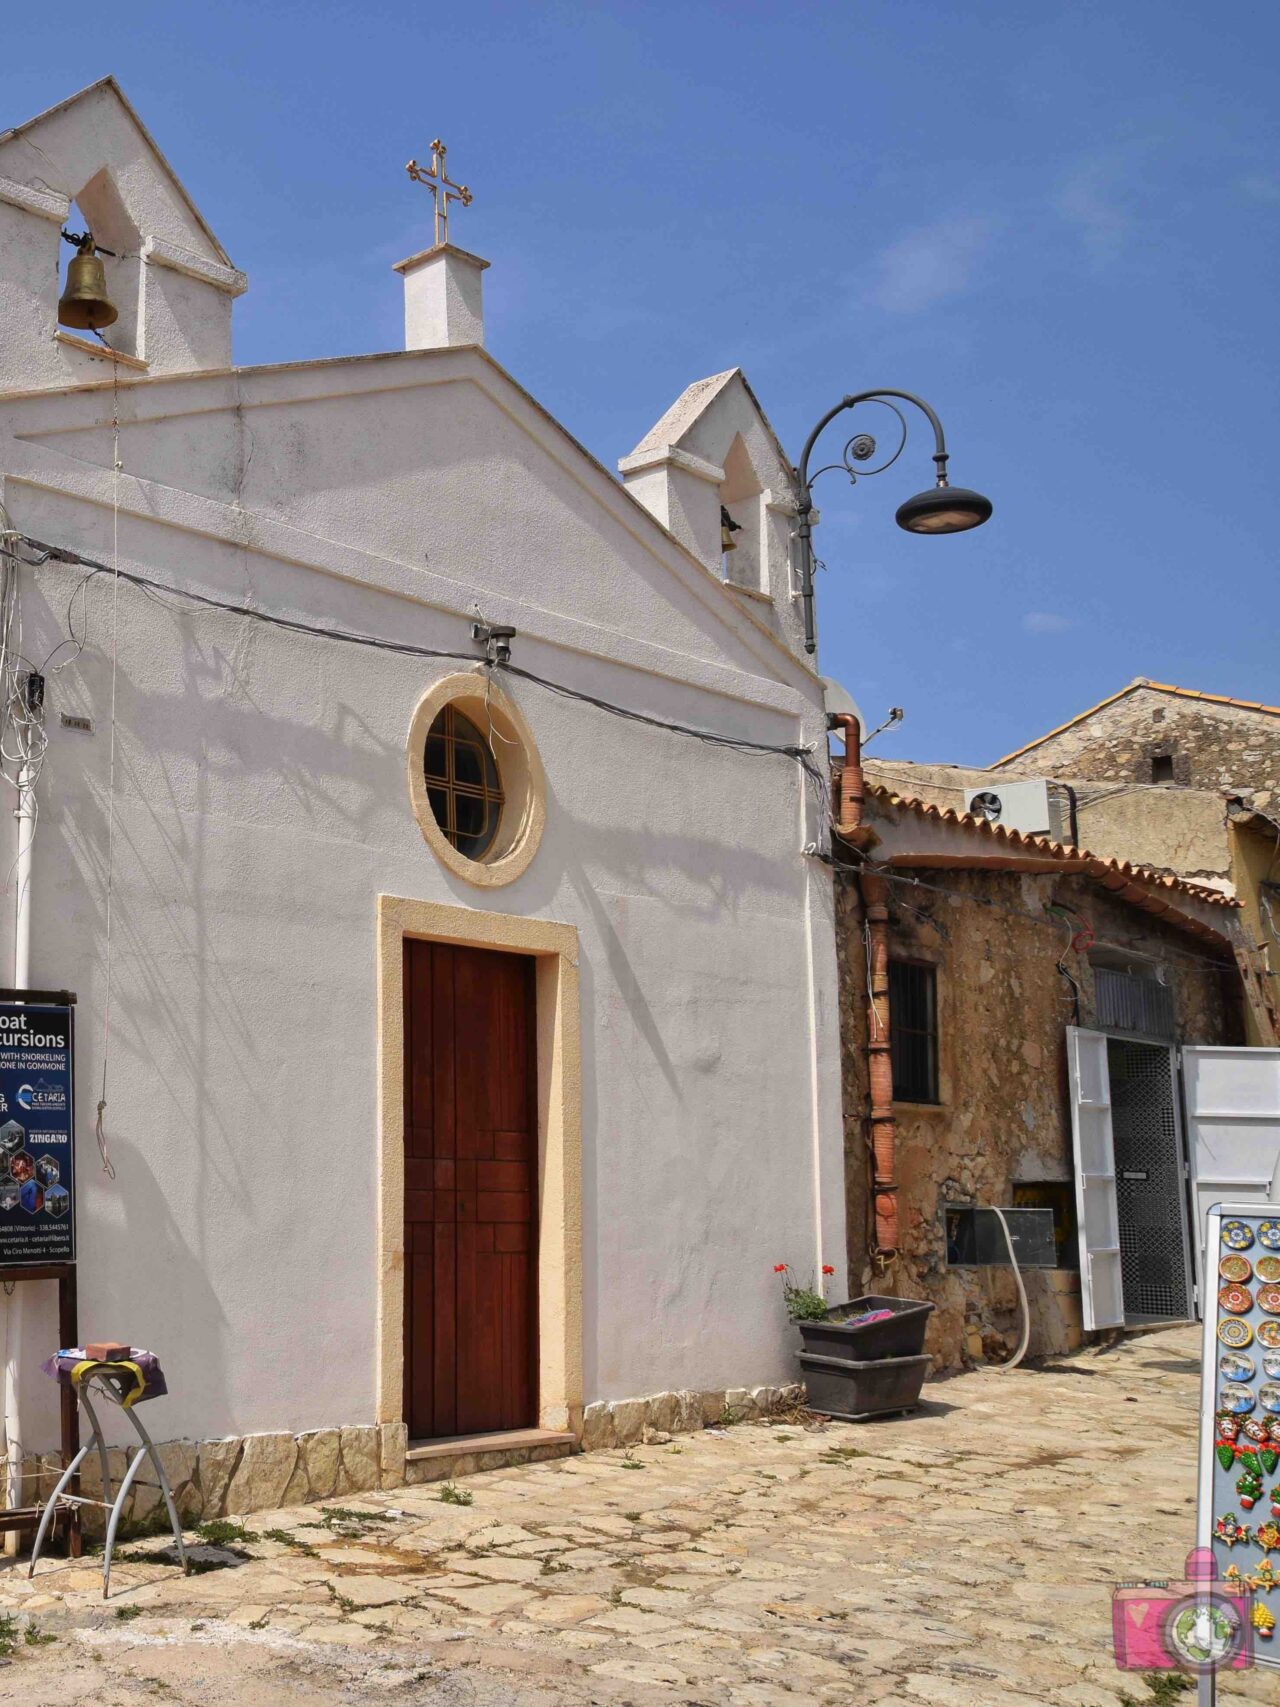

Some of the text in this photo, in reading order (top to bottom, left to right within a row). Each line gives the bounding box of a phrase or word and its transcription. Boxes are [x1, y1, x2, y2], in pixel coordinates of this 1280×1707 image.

[0, 1051, 66, 1062] WITH SNORKELING
[17, 1061, 26, 1069] IN
[26, 1062, 66, 1071] GOMMONE
[32, 1092, 66, 1102] CETARIA
[29, 1134, 68, 1144] ZINGARO
